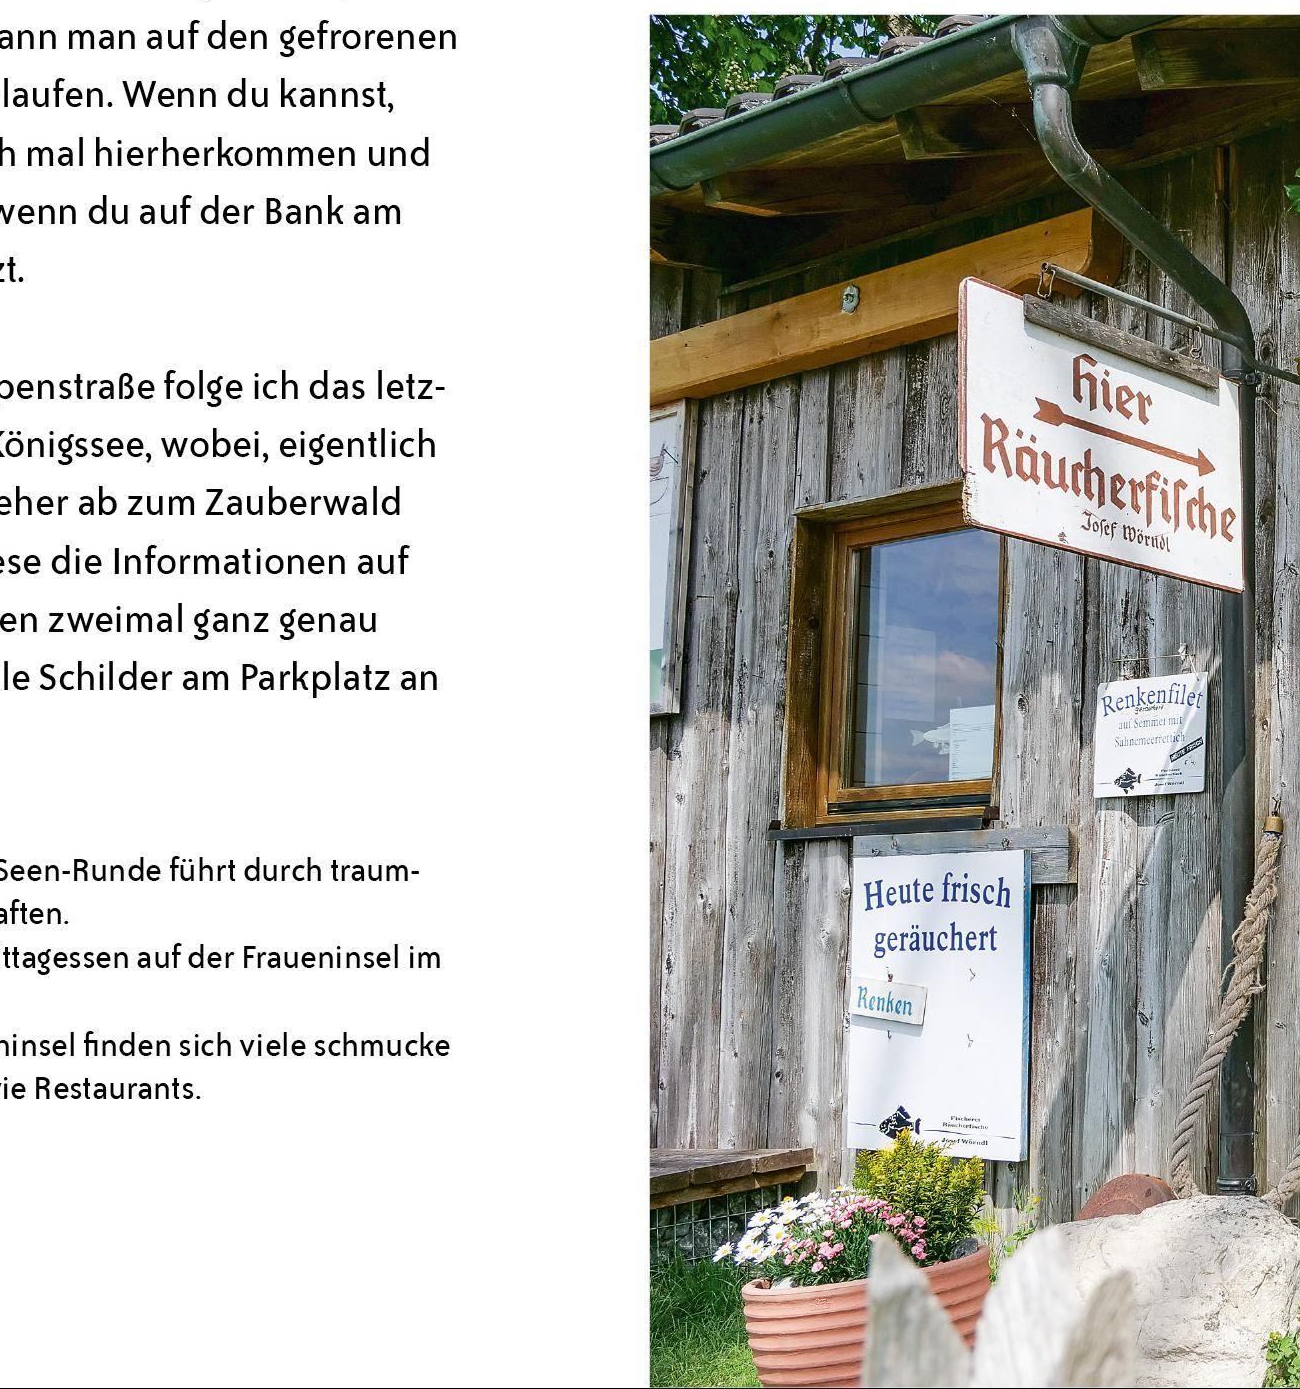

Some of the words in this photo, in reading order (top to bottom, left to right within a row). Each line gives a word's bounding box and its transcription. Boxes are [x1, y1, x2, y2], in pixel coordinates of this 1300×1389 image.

[121, 80, 217, 108] Wenn
[227, 77, 269, 108] du
[280, 77, 394, 114] kannst,
[160, 427, 269, 464] wobei,
[279, 427, 436, 466] eigentlich
[1081, 511, 1118, 541] Josef
[1100, 682, 1204, 717] Renkenfilet
[169, 855, 236, 882] führt
[244, 856, 322, 882] durch
[330, 859, 420, 882] traum-
[863, 877, 934, 911] Heute
[941, 872, 1012, 909] frisch
[137, 942, 182, 969] auf
[188, 943, 235, 969] der
[243, 943, 399, 969] Fraueninsel
[409, 945, 441, 969] im
[873, 921, 998, 959] geräuchert
[857, 985, 913, 1017] Renken
[83, 1030, 171, 1057] finden
[179, 1031, 232, 1057] sich
[239, 1031, 306, 1057] viele
[314, 1031, 450, 1057] schmucke
[35, 1076, 201, 1100] Restaurants.
